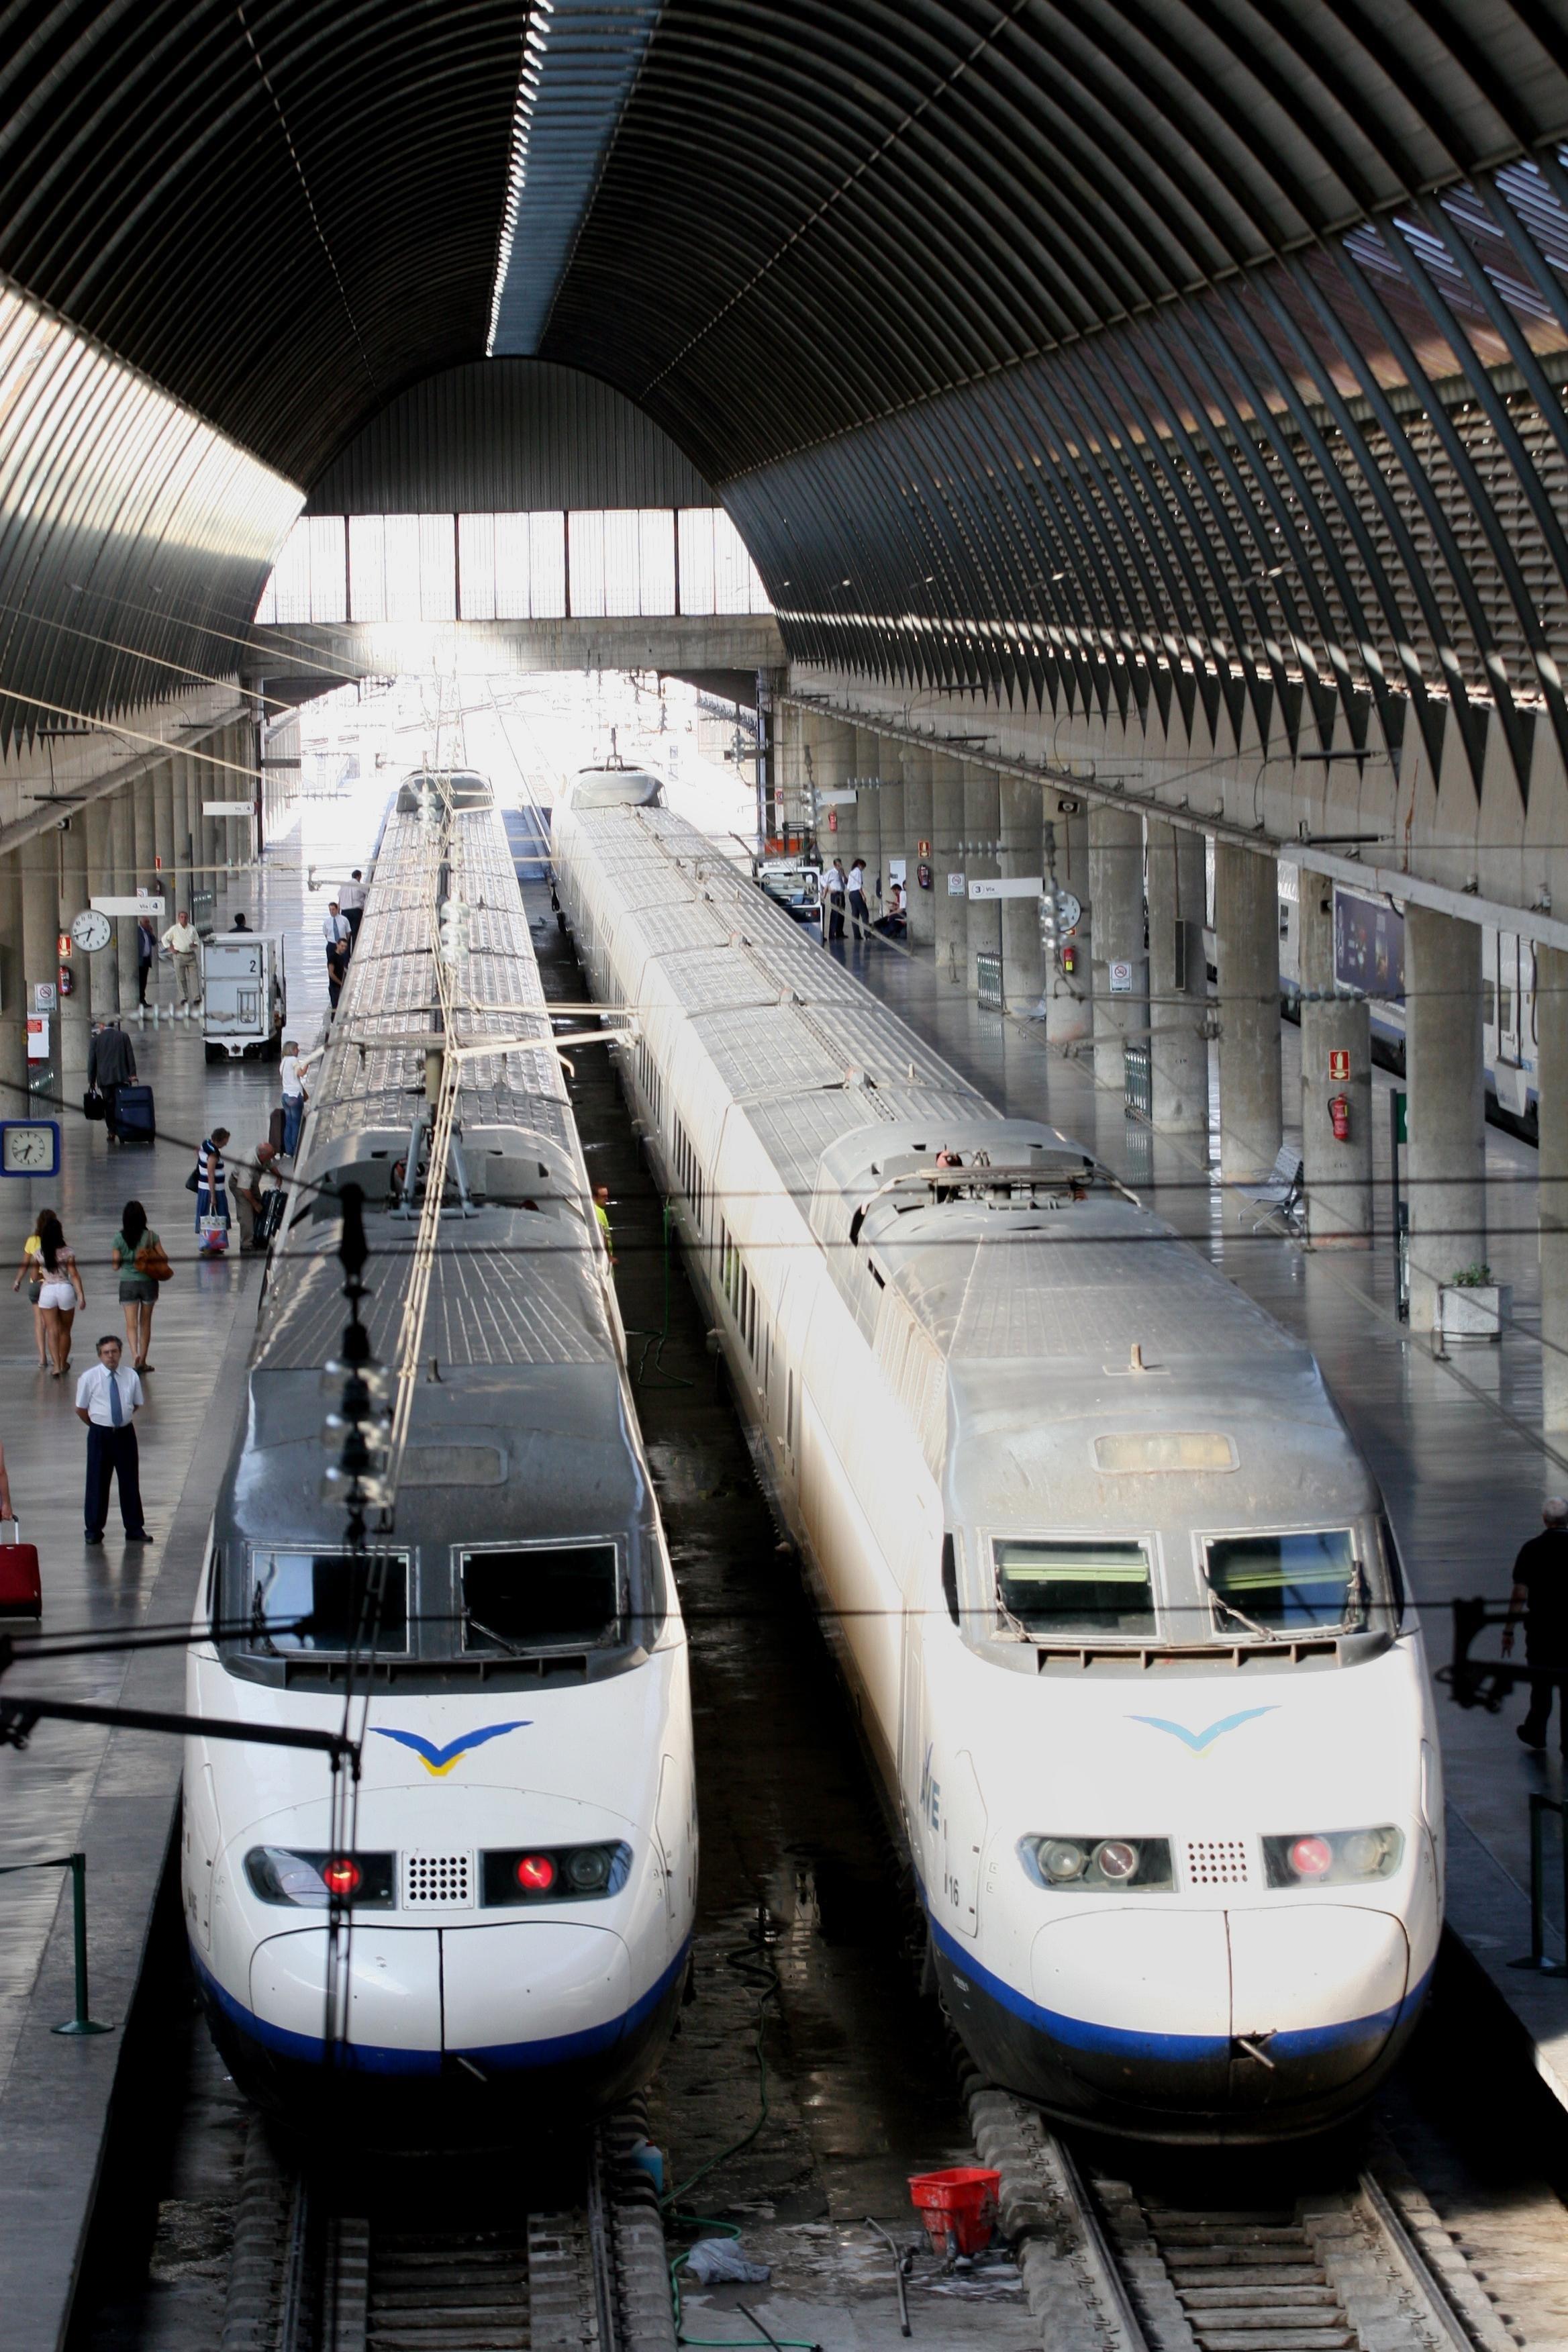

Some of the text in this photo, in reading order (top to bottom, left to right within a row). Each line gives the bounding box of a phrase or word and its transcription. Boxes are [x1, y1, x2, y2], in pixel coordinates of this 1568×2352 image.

[975, 885, 981, 893] 3
[152, 901, 158, 910] 4
[250, 960, 256, 973] 2
[920, 1757, 940, 1832] AVE
[948, 1875, 959, 1907] 16
